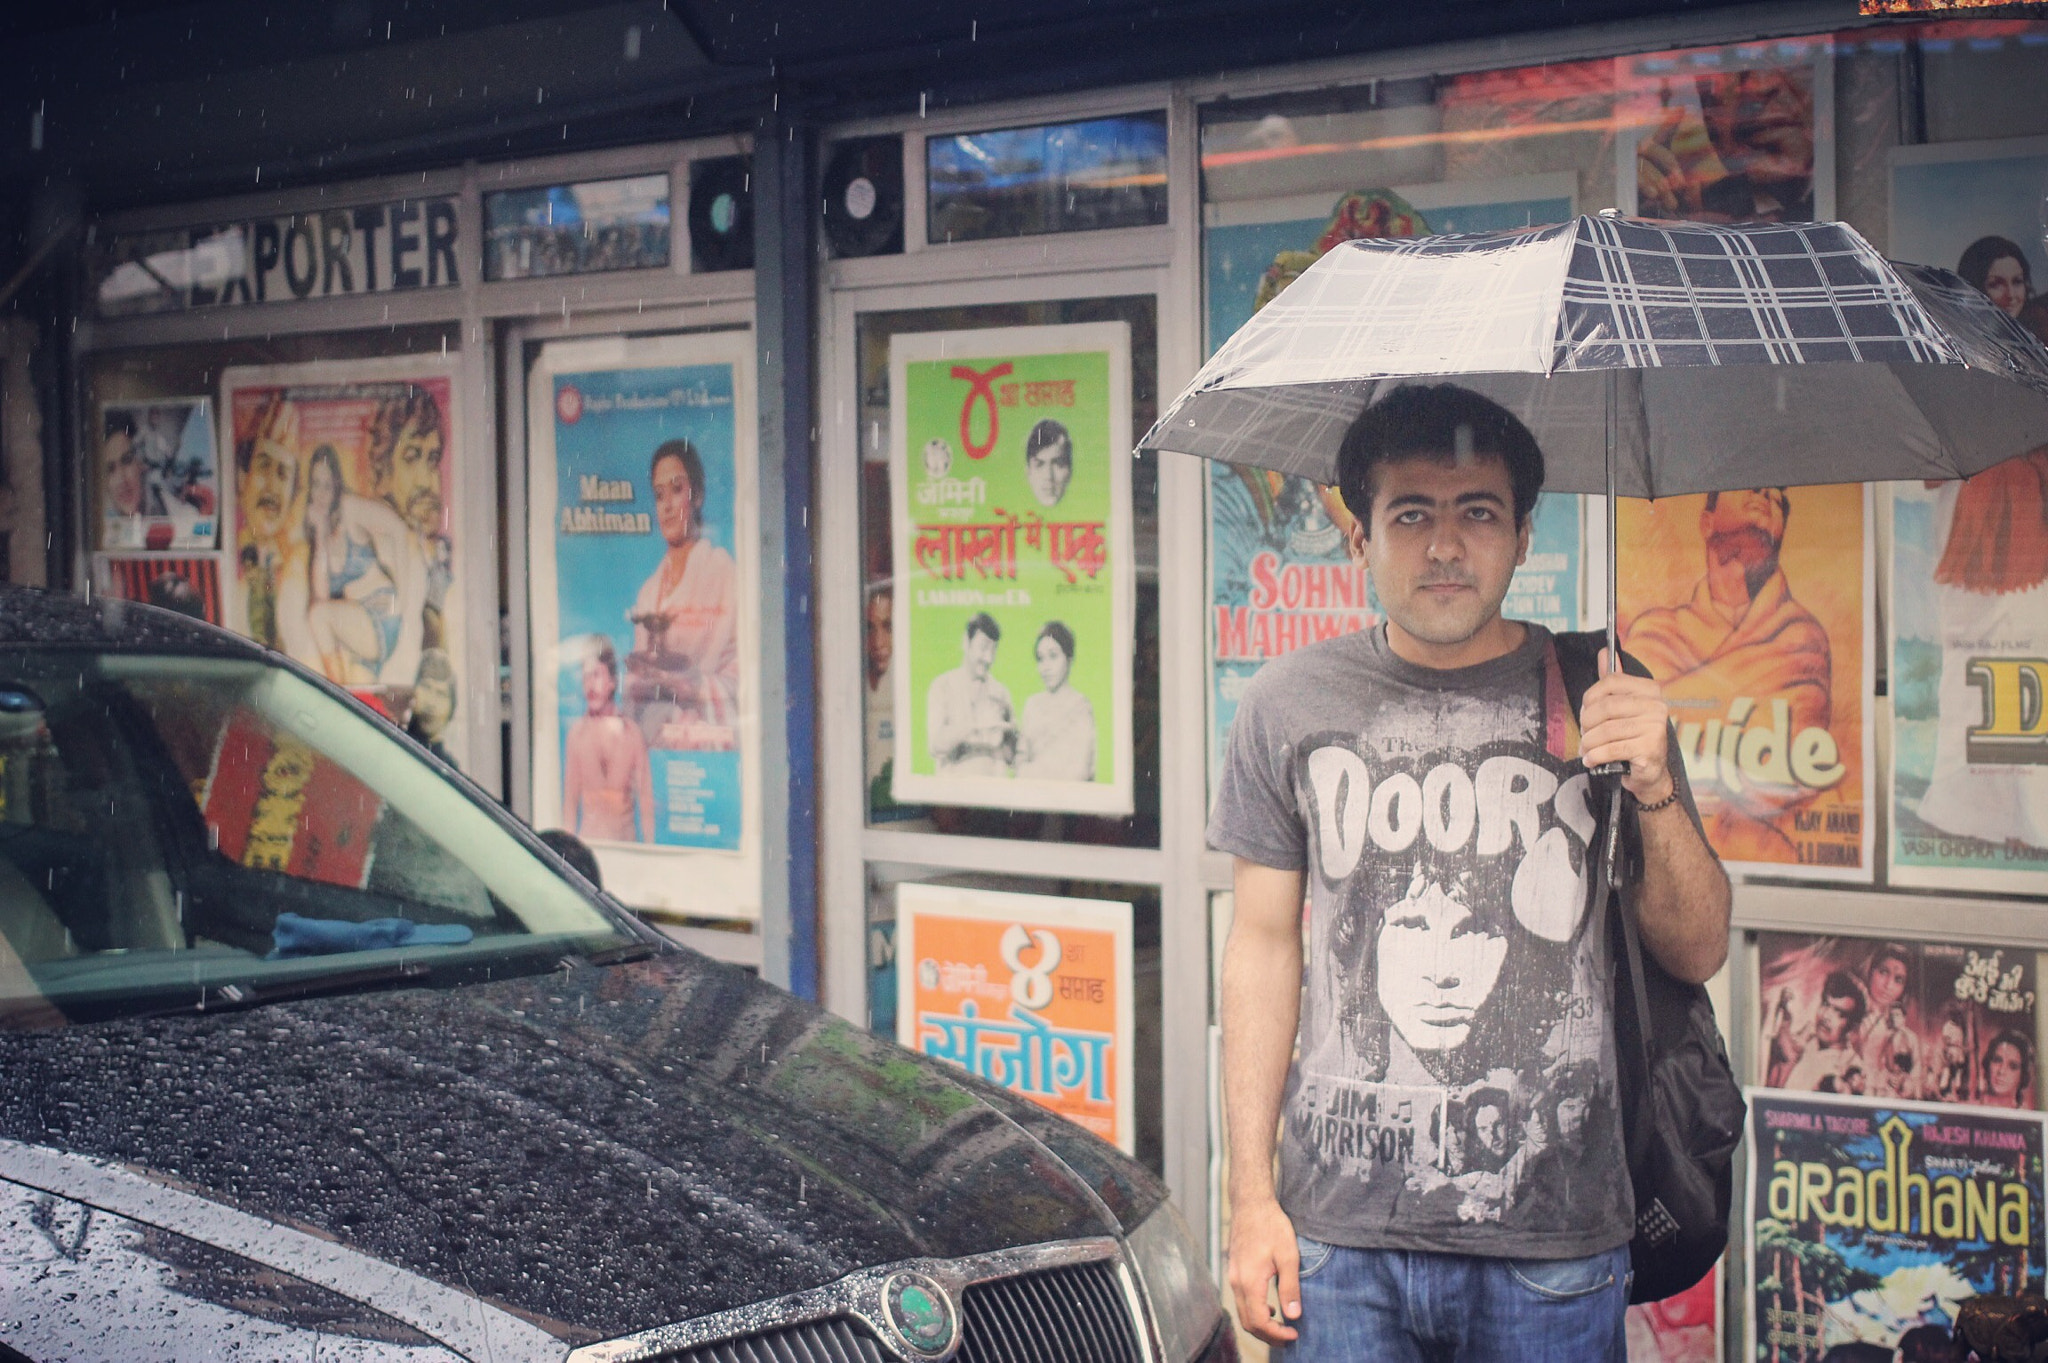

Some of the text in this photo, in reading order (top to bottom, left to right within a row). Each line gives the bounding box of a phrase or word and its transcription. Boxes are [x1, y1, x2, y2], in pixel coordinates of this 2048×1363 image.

[579, 474, 634, 502] Maan
[560, 505, 652, 535] Abhiman
[1250, 551, 1366, 611] SOHNI
[1670, 696, 1846, 794] uide
[1307, 745, 1597, 943] DOORS
[1326, 1086, 1378, 1122] JIM
[1921, 1124, 1970, 1146] RAJESH
